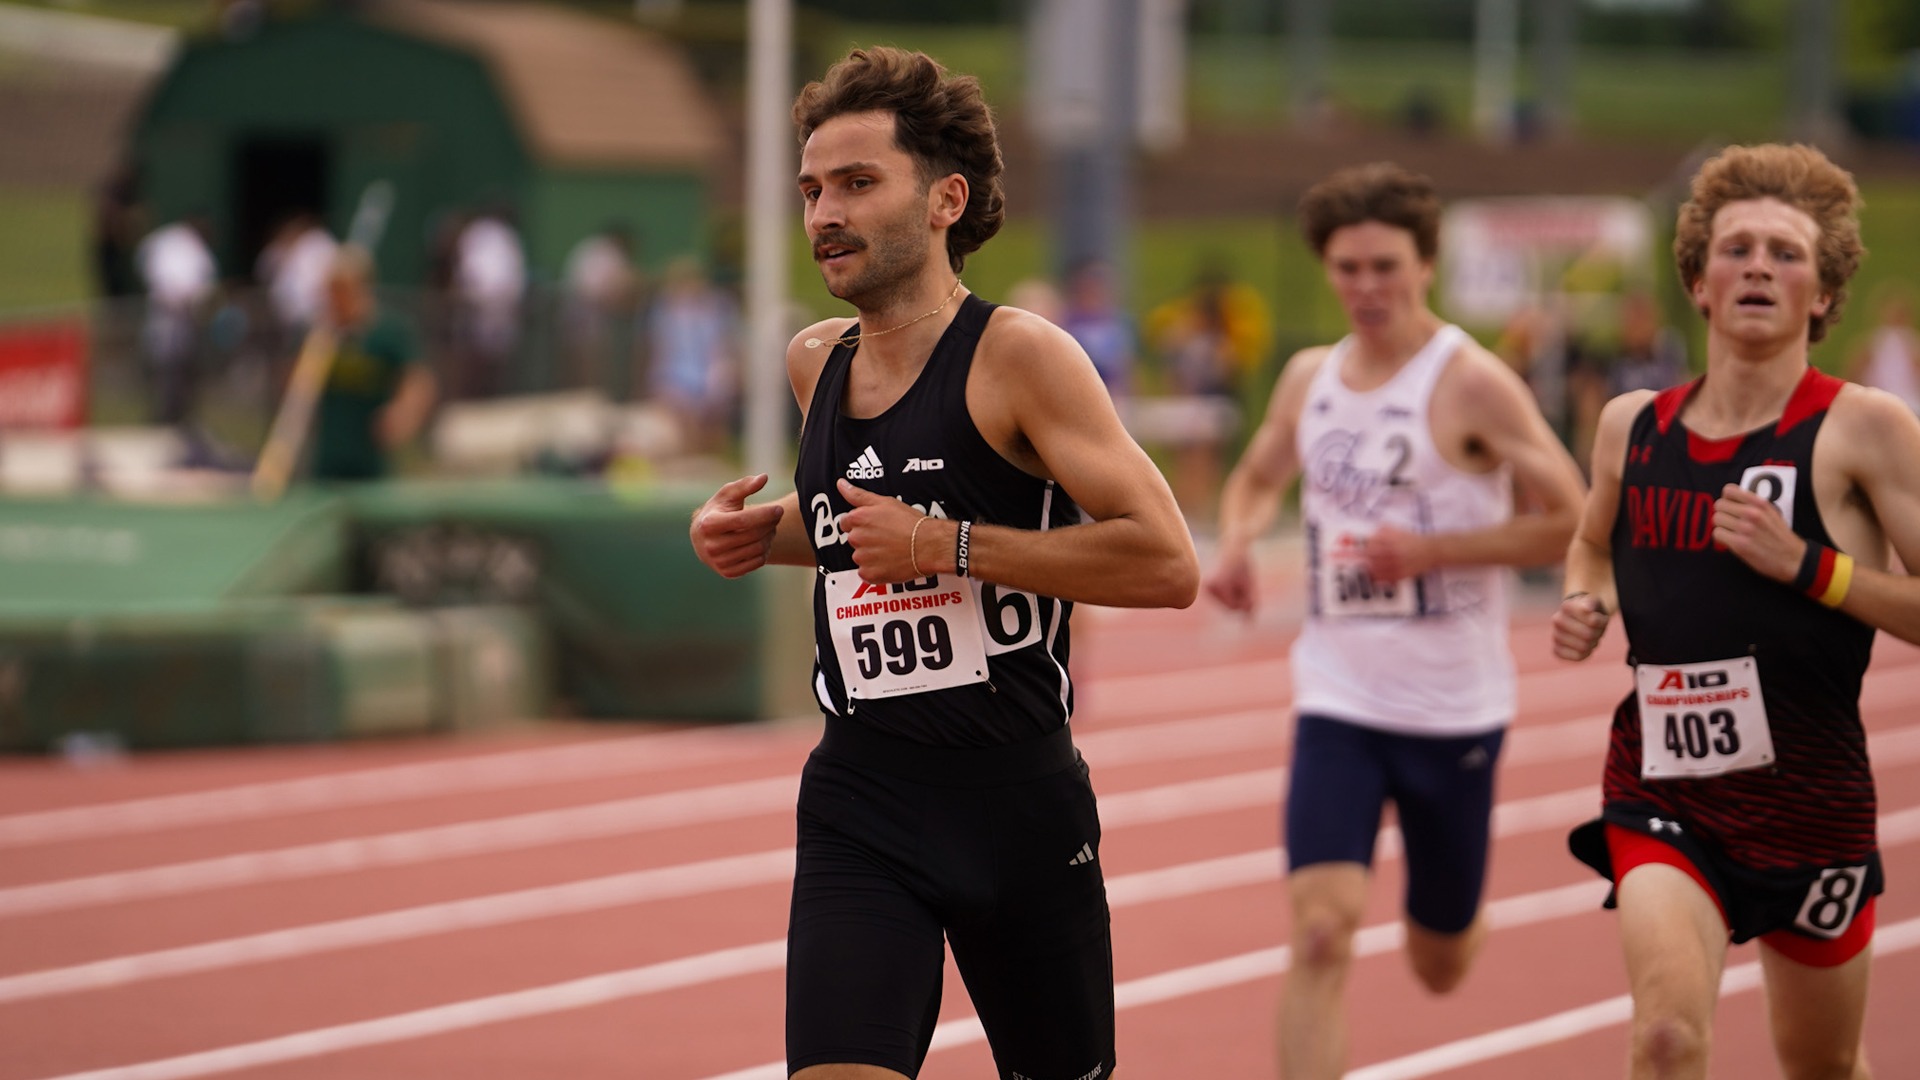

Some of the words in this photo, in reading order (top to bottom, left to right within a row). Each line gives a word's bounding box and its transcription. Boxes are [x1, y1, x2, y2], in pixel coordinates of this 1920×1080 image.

[902, 458, 944, 473] A10
[1385, 432, 1414, 487] 2
[1628, 485, 1728, 551] DAVID
[836, 591, 962, 619] CHAMPIONSHIPS
[981, 581, 1032, 645] 6
[852, 615, 953, 679] 599
[1657, 669, 1729, 690] A10
[1665, 708, 1741, 759] 403
[1808, 870, 1856, 930] 8
